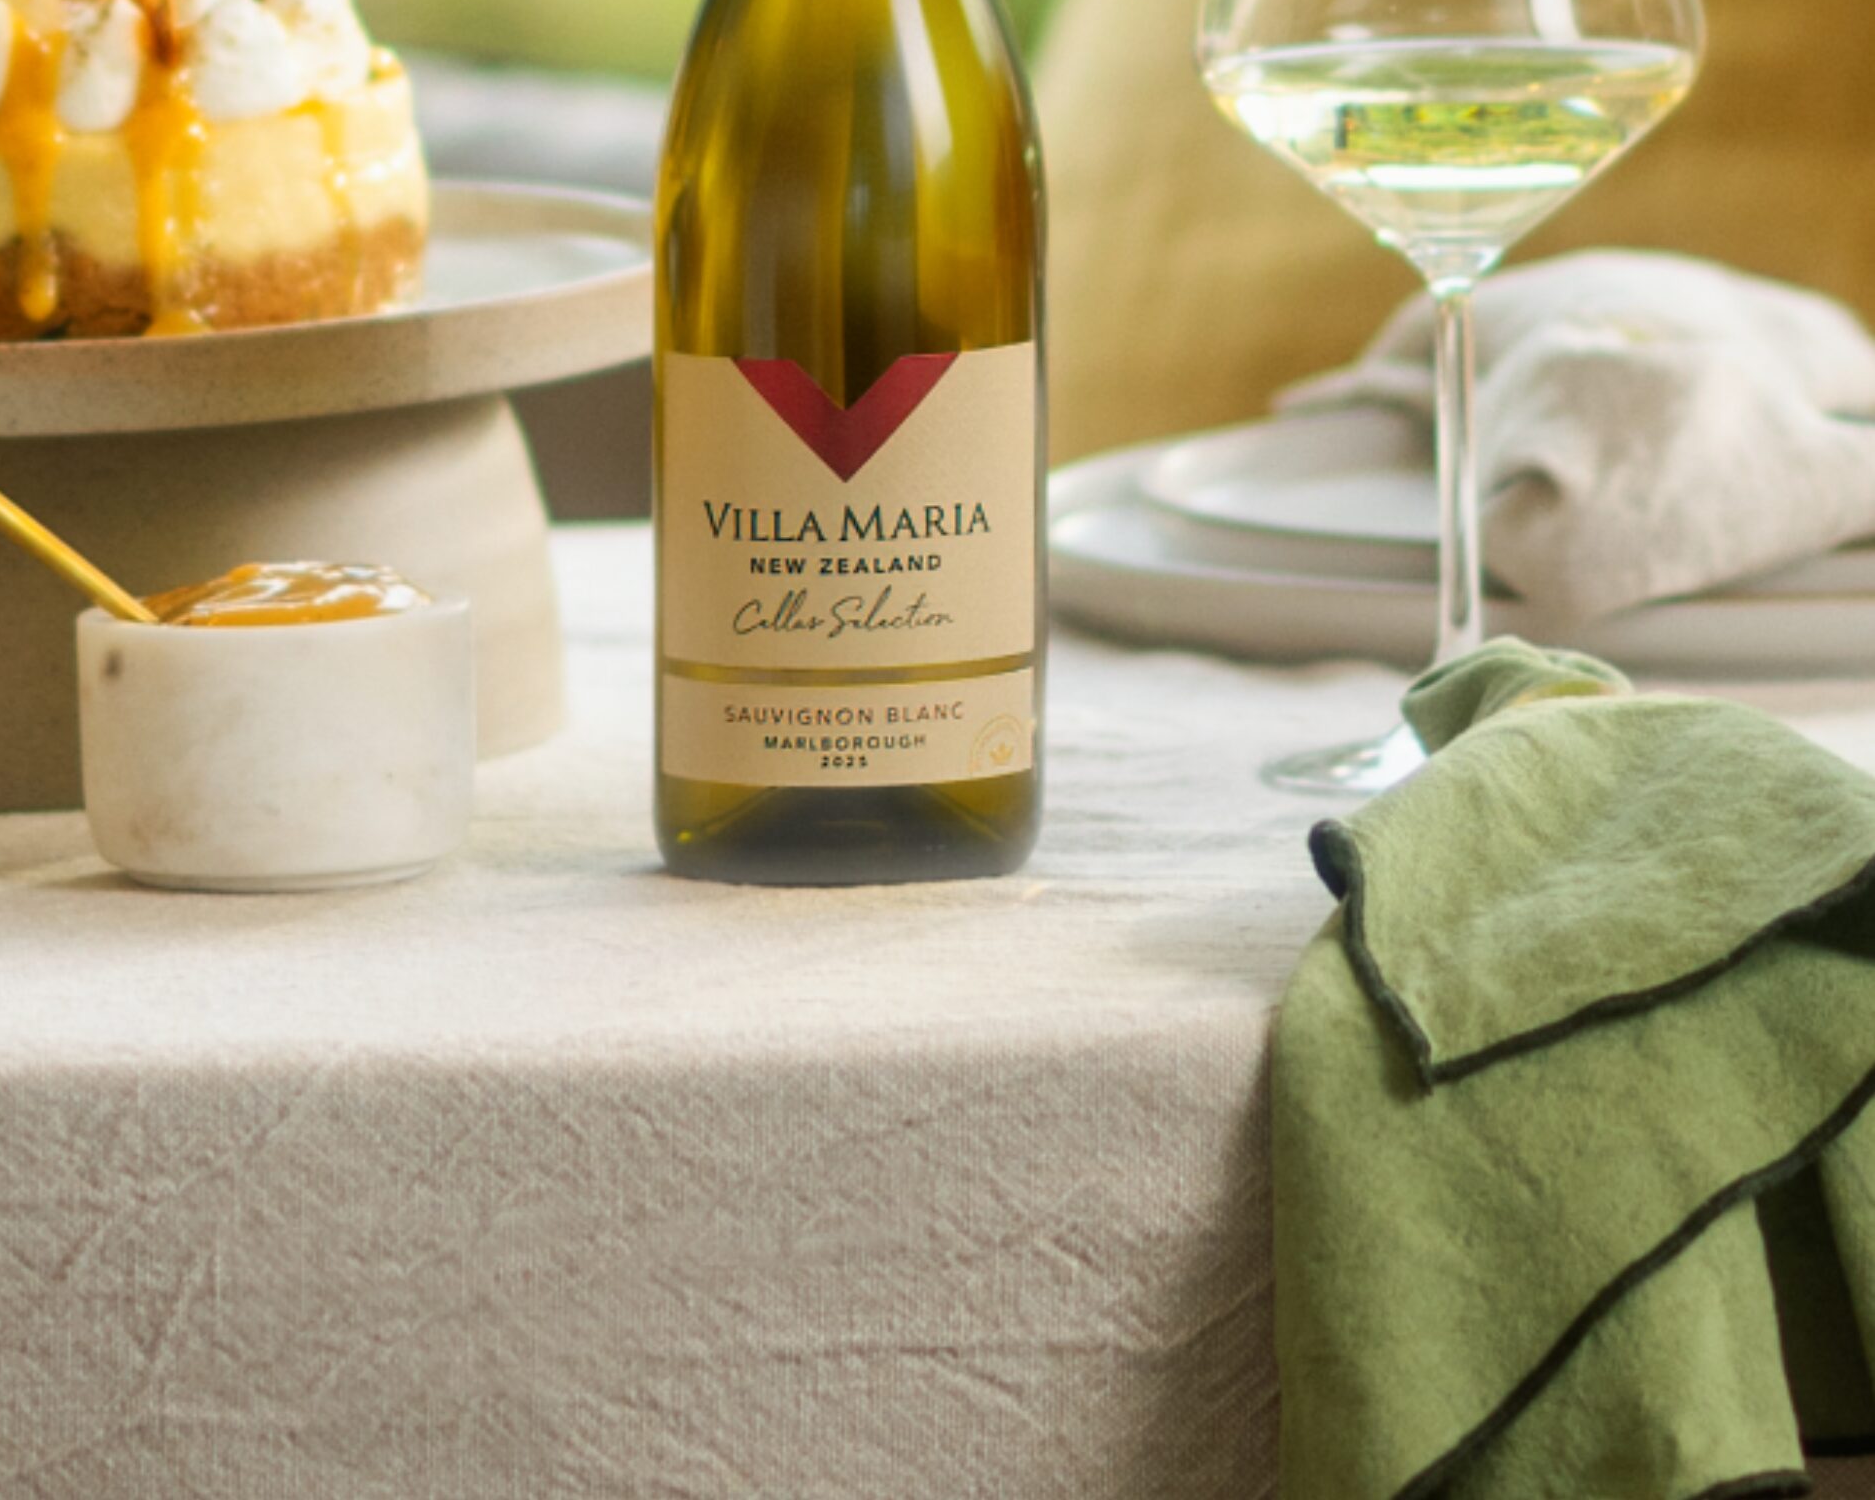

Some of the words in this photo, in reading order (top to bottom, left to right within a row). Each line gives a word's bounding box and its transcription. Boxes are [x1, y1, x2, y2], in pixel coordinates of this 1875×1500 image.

[704, 500, 827, 542] VILLA
[838, 503, 991, 542] MARIA
[750, 558, 807, 575] NEW
[820, 555, 942, 575] ZEALAND
[827, 584, 954, 639] Selection
[724, 705, 874, 726] SAUVIGNON
[887, 701, 963, 724] BLANC
[763, 735, 926, 751] MARLBOROUGH
